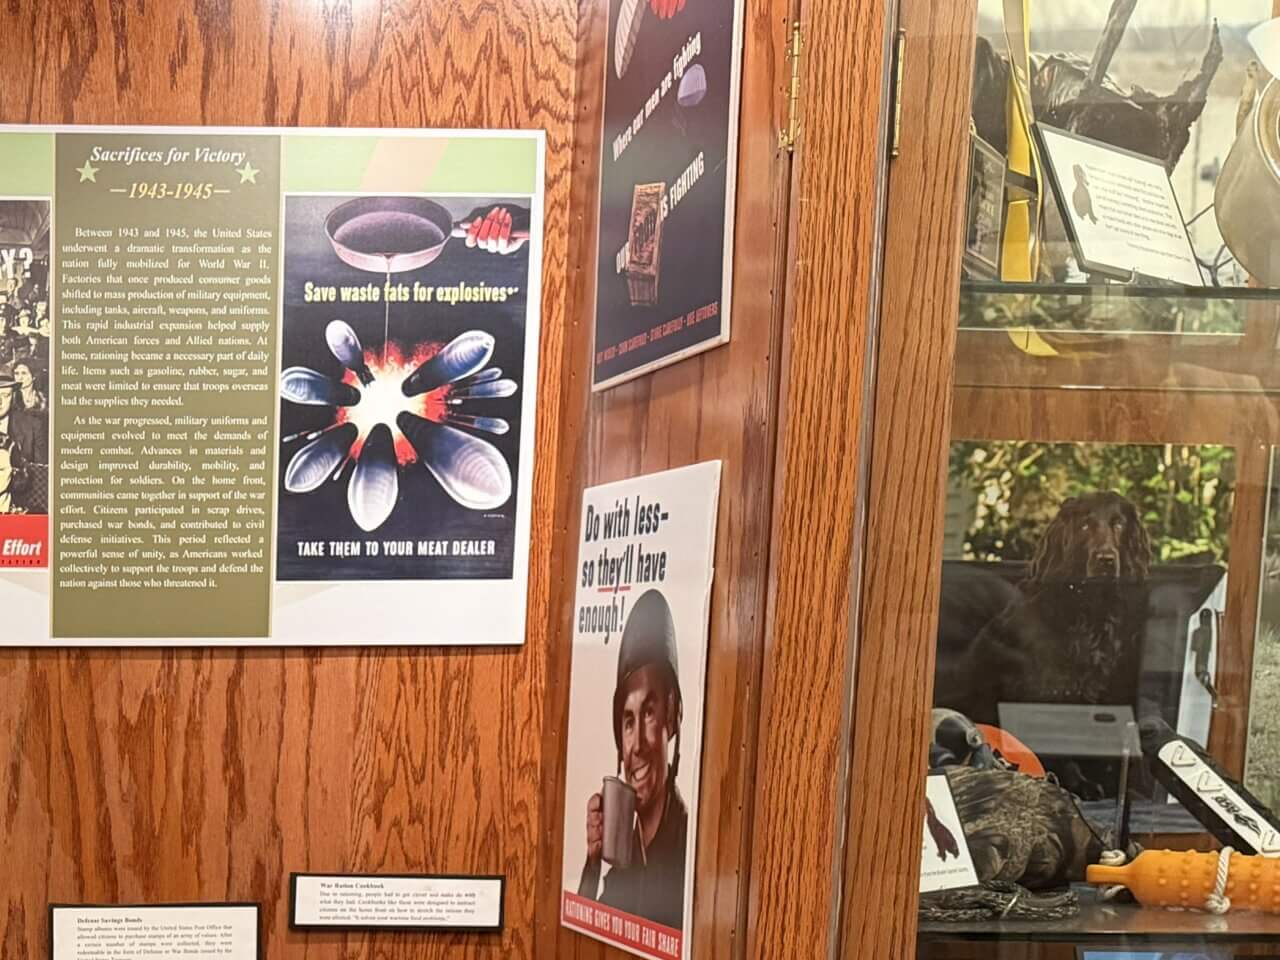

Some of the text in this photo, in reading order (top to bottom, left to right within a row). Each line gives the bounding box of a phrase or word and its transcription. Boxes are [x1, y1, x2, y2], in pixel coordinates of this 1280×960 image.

[612, 124, 632, 161] Where
[644, 91, 660, 120] men
[660, 70, 672, 98] are
[672, 31, 701, 86] fighting
[90, 146, 247, 166] Sacrifices for Victory
[660, 195, 669, 222] IS
[669, 151, 705, 211] FIGHTING
[75, 227, 273, 239] Between 1943 and 1945, the United States
[62, 243, 106, 253] underwent
[127, 243, 164, 253] dramatic
[172, 243, 234, 254] transformation
[240, 246, 251, 254] as
[258, 243, 271, 254] the
[62, 258, 271, 270] nation fully mobilized for World War II.
[62, 274, 100, 283] Factories
[106, 274, 122, 283] that
[153, 274, 193, 286] produced
[198, 276, 240, 284] consumer
[245, 274, 270, 287] goods
[62, 289, 90, 299] shifted
[93, 290, 102, 299] to
[128, 289, 173, 301] production
[176, 289, 186, 299] of
[187, 290, 221, 302] military
[222, 290, 270, 302] equipment,
[304, 282, 336, 302] Save
[340, 283, 380, 302] waste
[384, 283, 410, 302] fats
[413, 282, 434, 301] for
[585, 504, 600, 543] Do
[603, 500, 630, 540] with
[3, 540, 41, 556] Effort
[298, 540, 494, 557] TAKE THEM TO YOUR MEAT DEALER
[582, 544, 668, 593] so they'll have
[579, 594, 625, 646] enough!
[565, 898, 678, 957] RATIONING GIVES YOU YOUR FAIR SHARE
